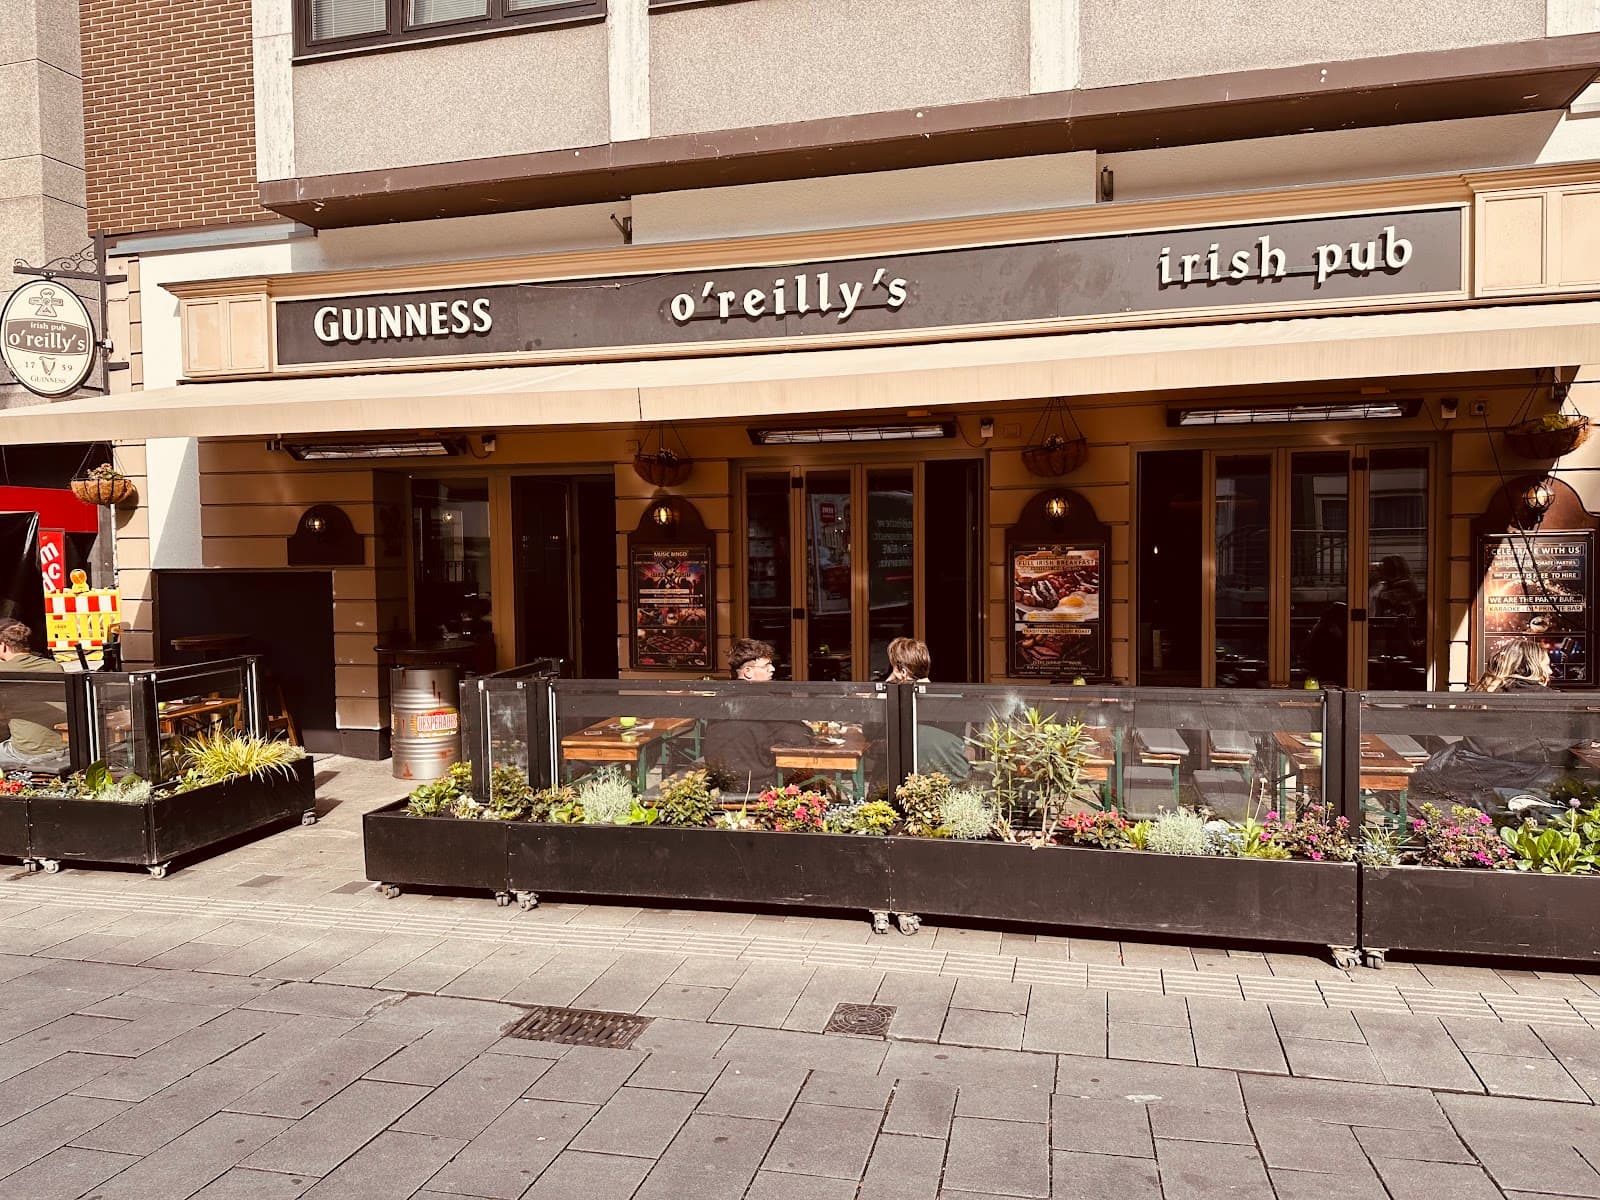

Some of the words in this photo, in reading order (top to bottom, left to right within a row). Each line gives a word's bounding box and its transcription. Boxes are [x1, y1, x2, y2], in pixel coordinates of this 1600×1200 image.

[1158, 234, 1287, 284] irish
[1315, 225, 1413, 283] pub
[670, 267, 907, 321] o'reilly's
[30, 321, 49, 330] irish
[50, 323, 67, 331] pub
[313, 298, 493, 342] GUINNESS
[8, 329, 86, 353] o'reilly's
[30, 375, 66, 384] GUINNESS
[1491, 547, 1540, 556] CELERAE
[1541, 546, 1565, 554] WITH
[1567, 546, 1581, 554] US
